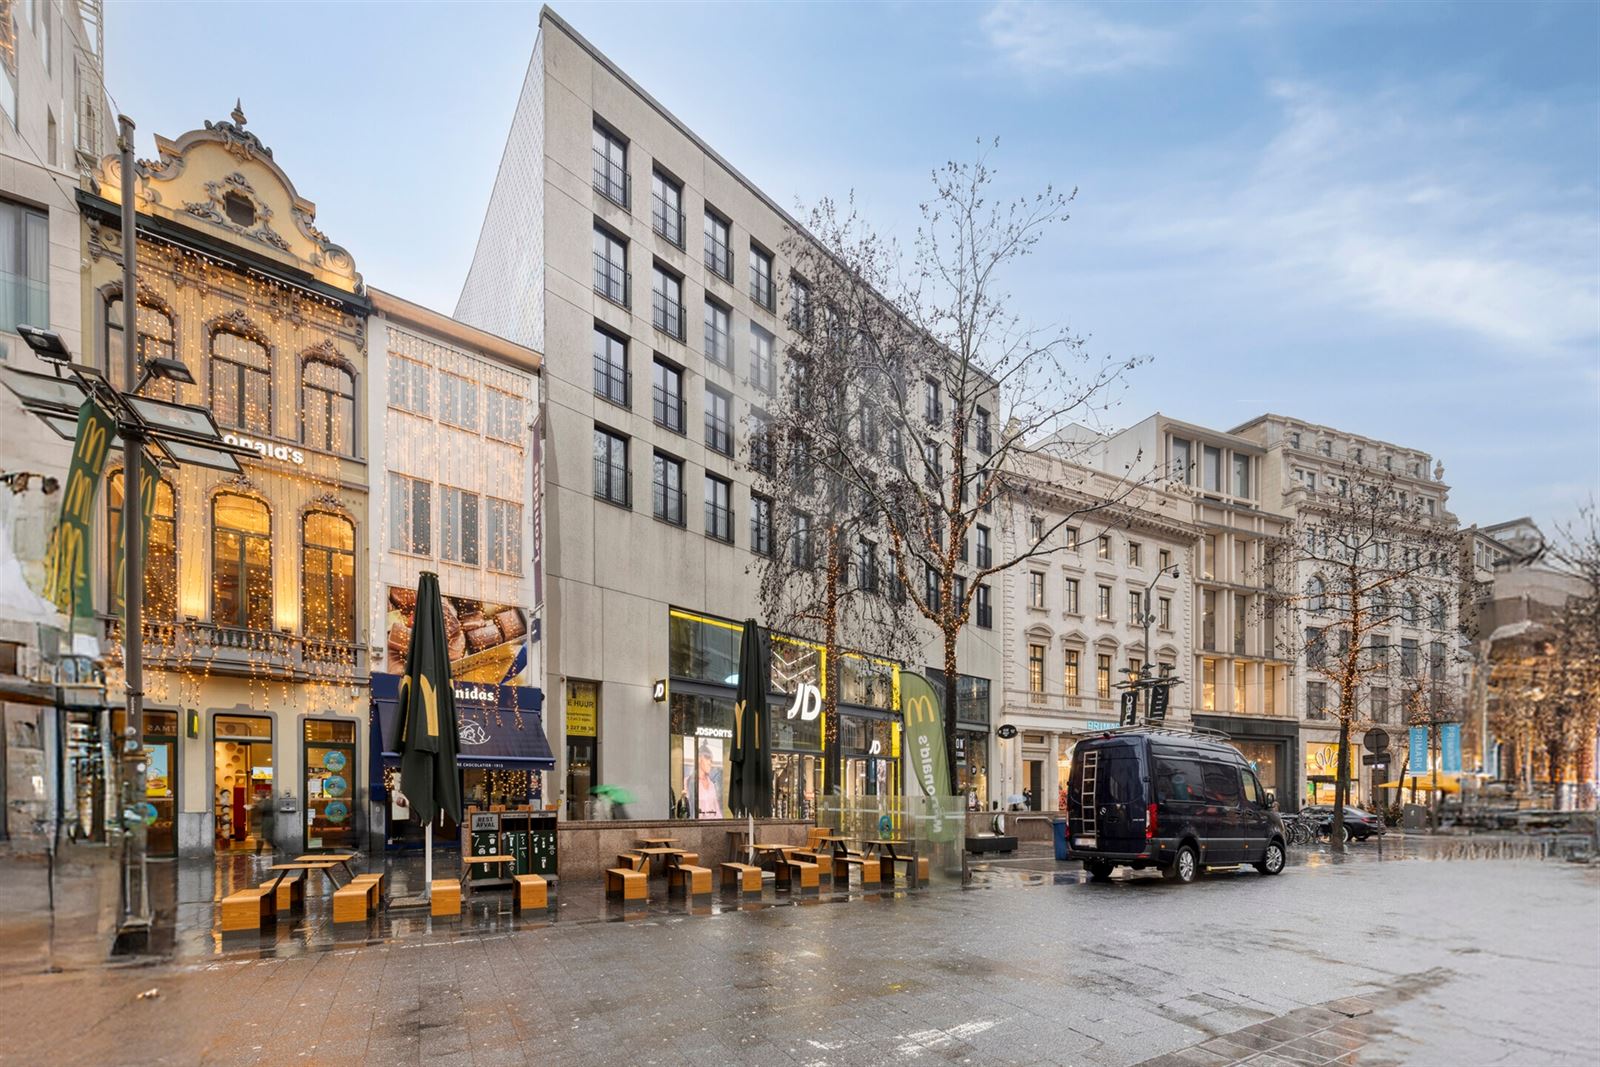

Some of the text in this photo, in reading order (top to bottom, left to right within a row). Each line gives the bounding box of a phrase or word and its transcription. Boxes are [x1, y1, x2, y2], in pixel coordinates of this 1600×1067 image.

[223, 434, 304, 464] onald's
[455, 685, 495, 701] nidas
[654, 683, 664, 698] JD
[787, 683, 822, 721] JD
[695, 727, 733, 738] JDSPORTS
[869, 740, 881, 755] JD
[1415, 728, 1423, 769] PRIMARK
